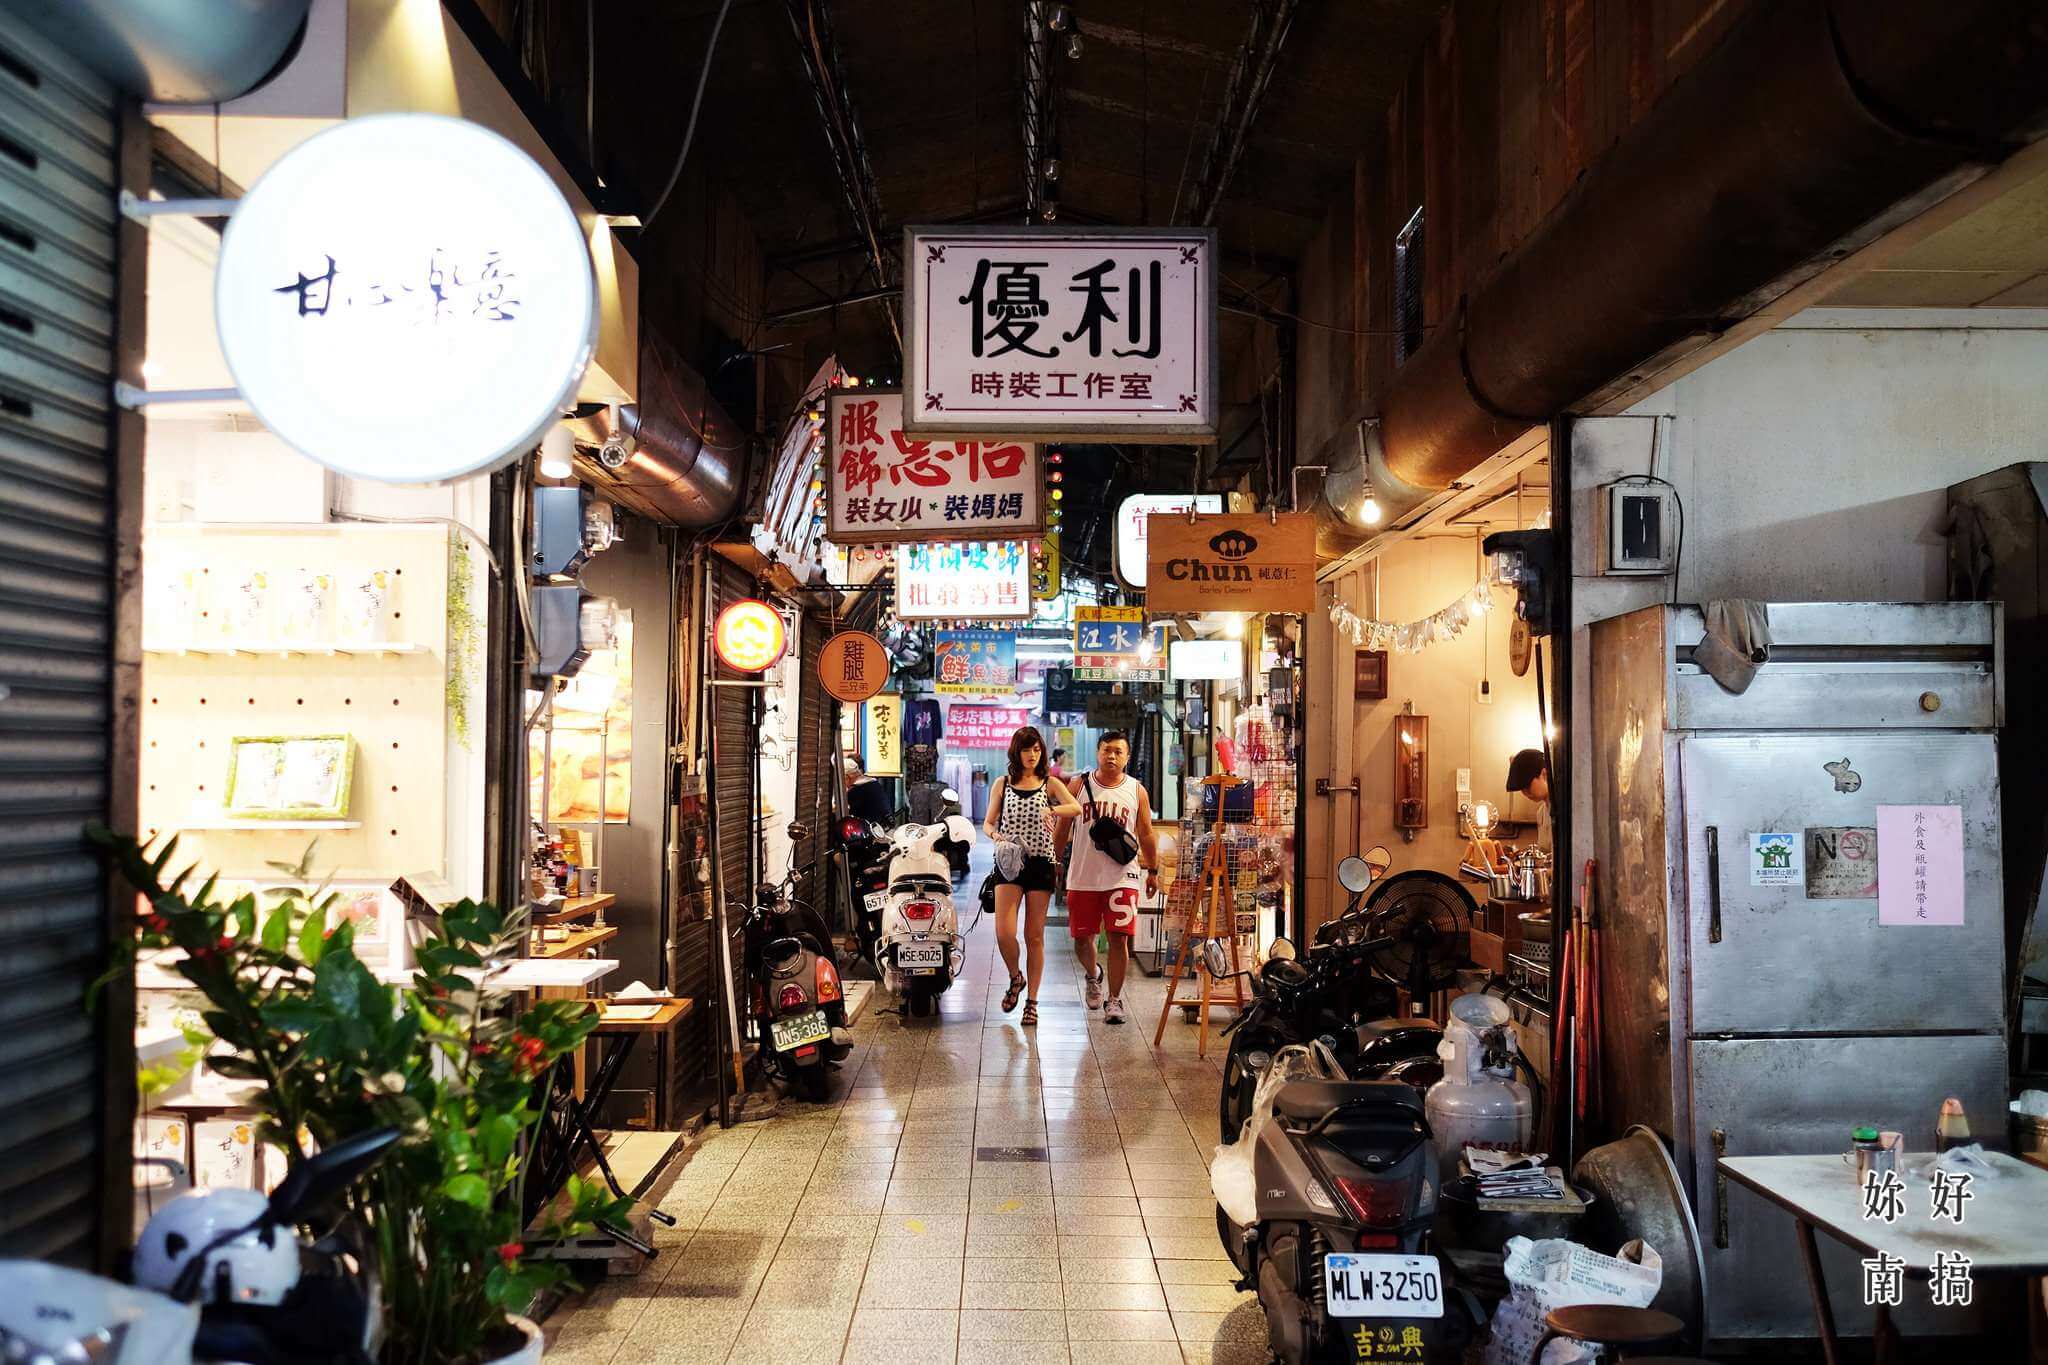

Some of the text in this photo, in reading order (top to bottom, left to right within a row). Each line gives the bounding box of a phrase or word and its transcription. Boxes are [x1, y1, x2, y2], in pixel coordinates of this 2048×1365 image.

[958, 258, 1161, 359] 優利
[971, 372, 1152, 399] 時裝工作室
[838, 400, 885, 496] 服飾
[1166, 558, 1252, 581] Chun
[1353, 1323, 1374, 1357] 吉
[1400, 1326, 1425, 1357] 興
